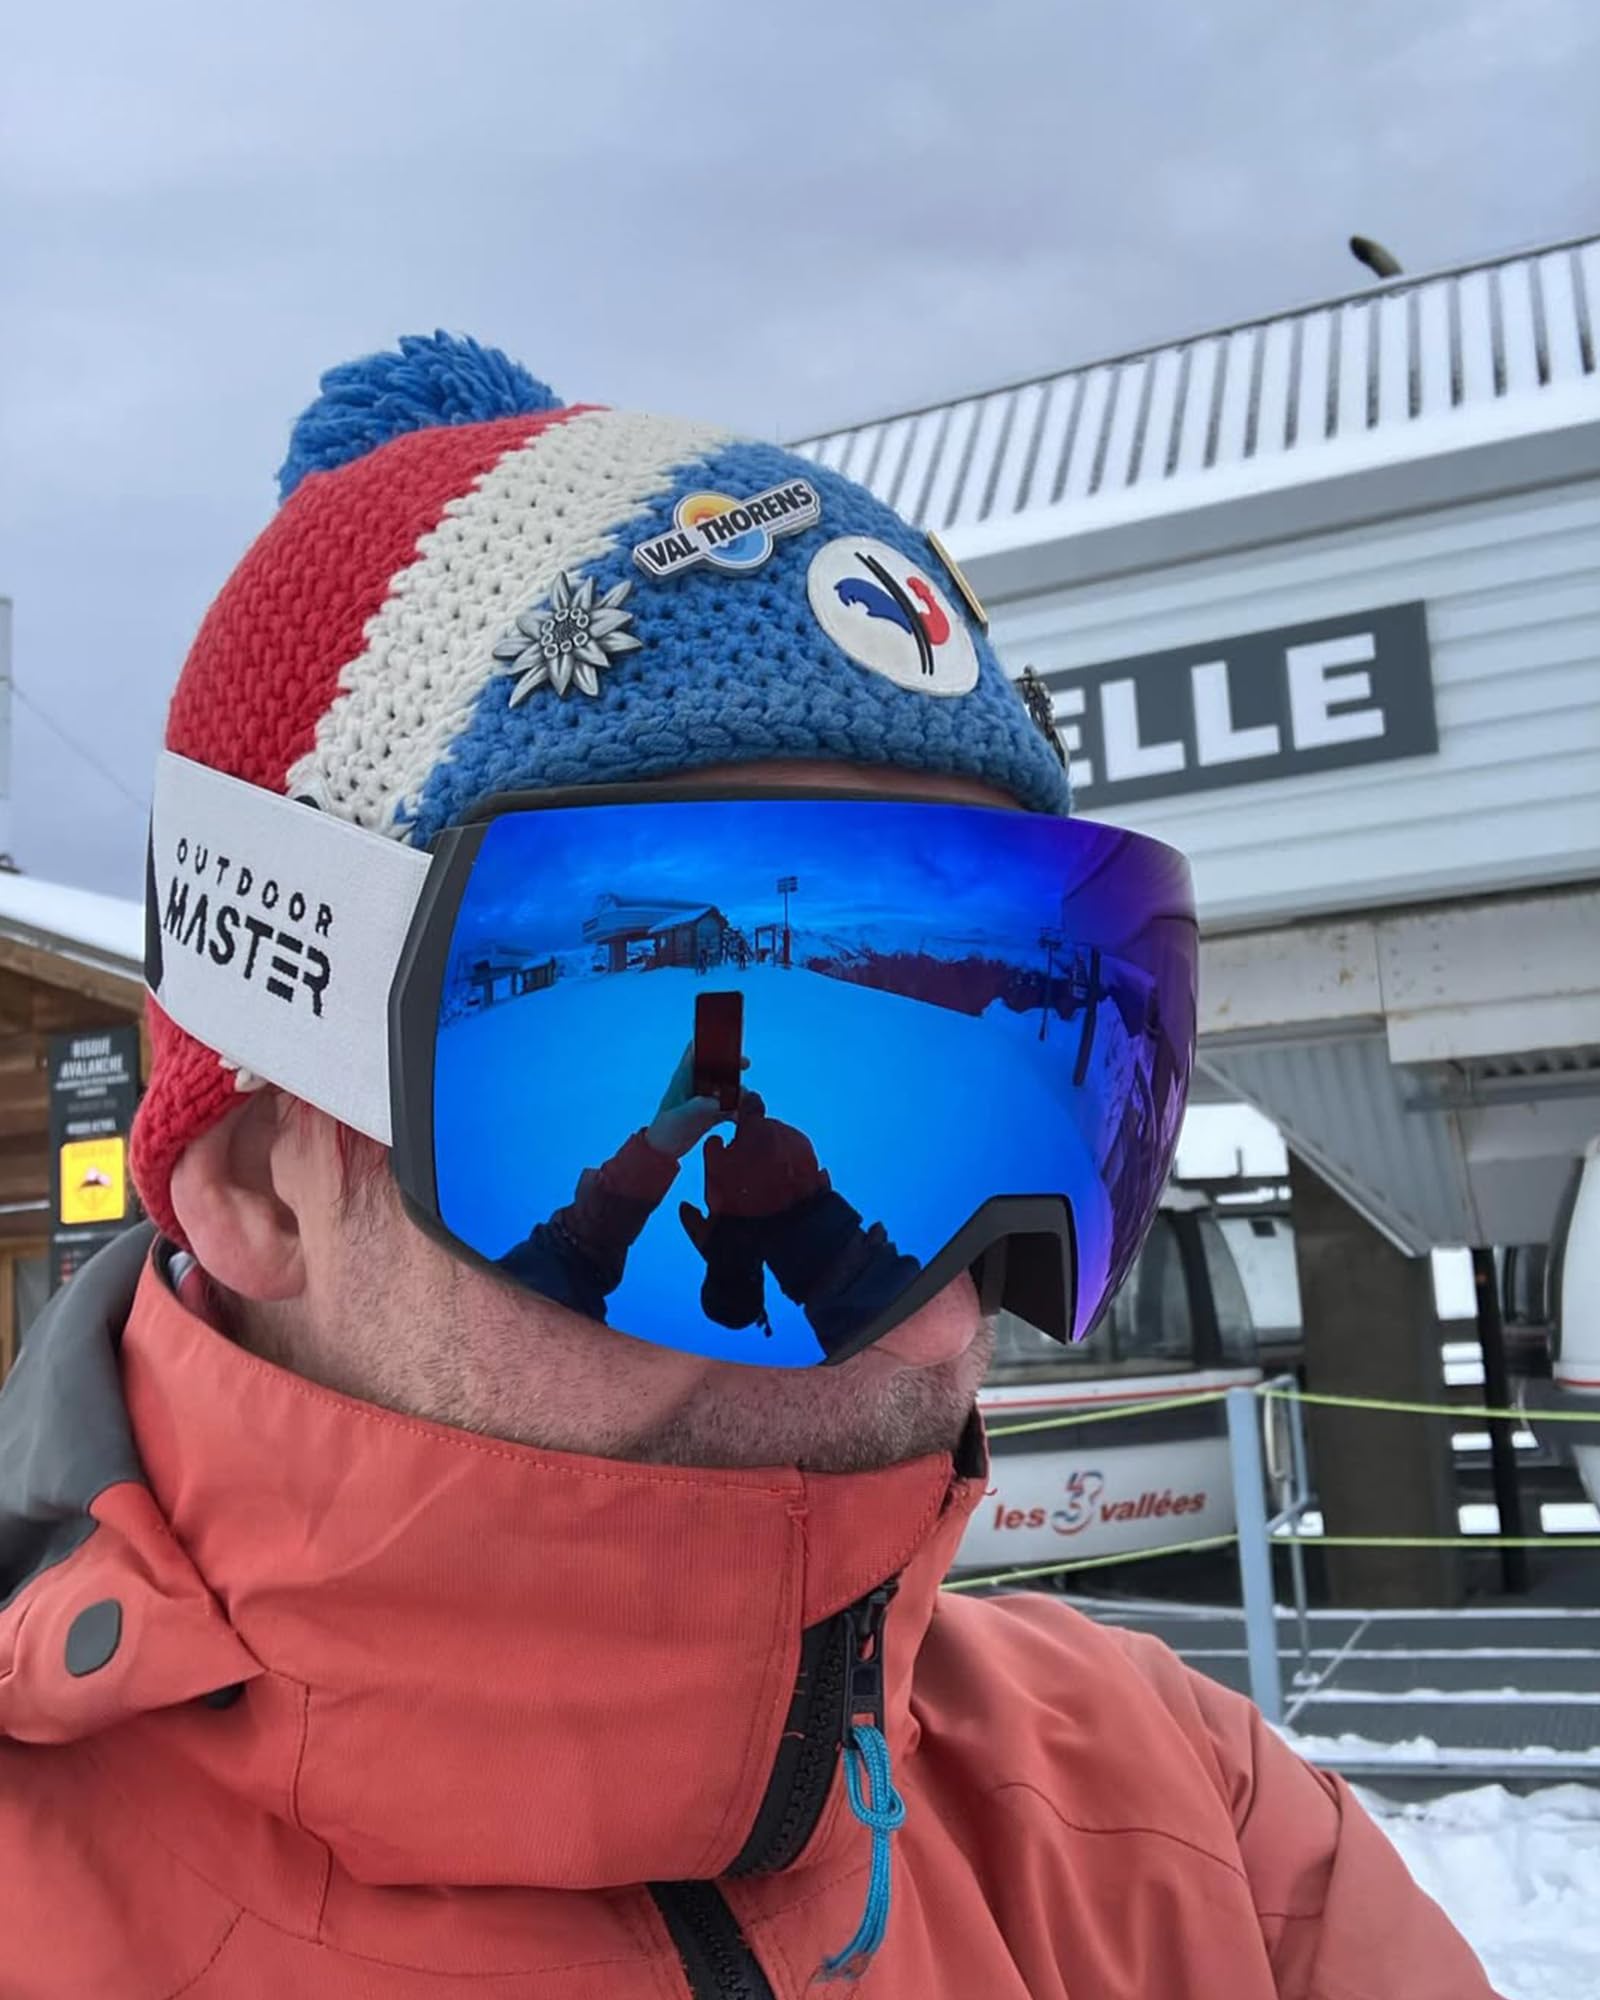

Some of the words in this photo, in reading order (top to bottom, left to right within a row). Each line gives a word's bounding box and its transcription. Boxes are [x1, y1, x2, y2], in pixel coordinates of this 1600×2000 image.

[644, 535, 701, 569] VAL
[695, 482, 814, 546] THORENS
[176, 837, 334, 937] OUTDOOR
[163, 875, 331, 1018] MASTER
[993, 1504, 1047, 1531] les
[1100, 1487, 1208, 1523] vallées
